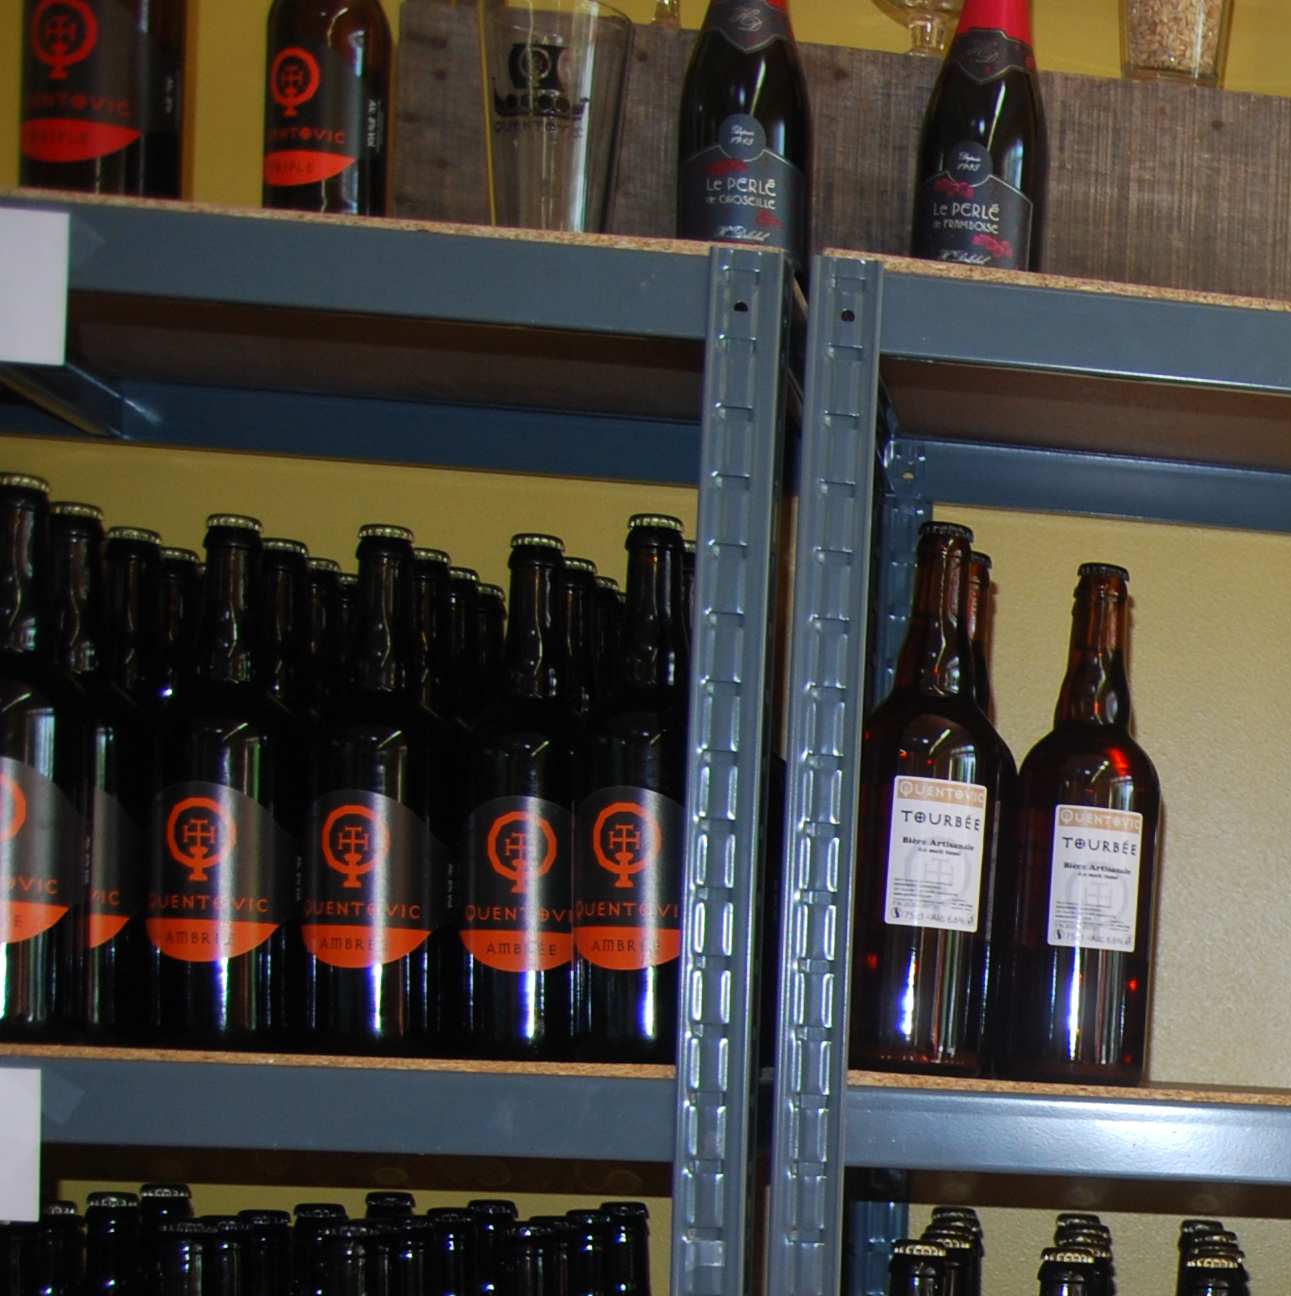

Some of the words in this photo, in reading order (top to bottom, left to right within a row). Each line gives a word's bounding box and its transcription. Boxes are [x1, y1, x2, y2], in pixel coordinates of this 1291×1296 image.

[901, 782, 984, 803] QUENTOVIC
[901, 810, 980, 832] TOURBÉE
[1062, 836, 1137, 856] TOURBÉE
